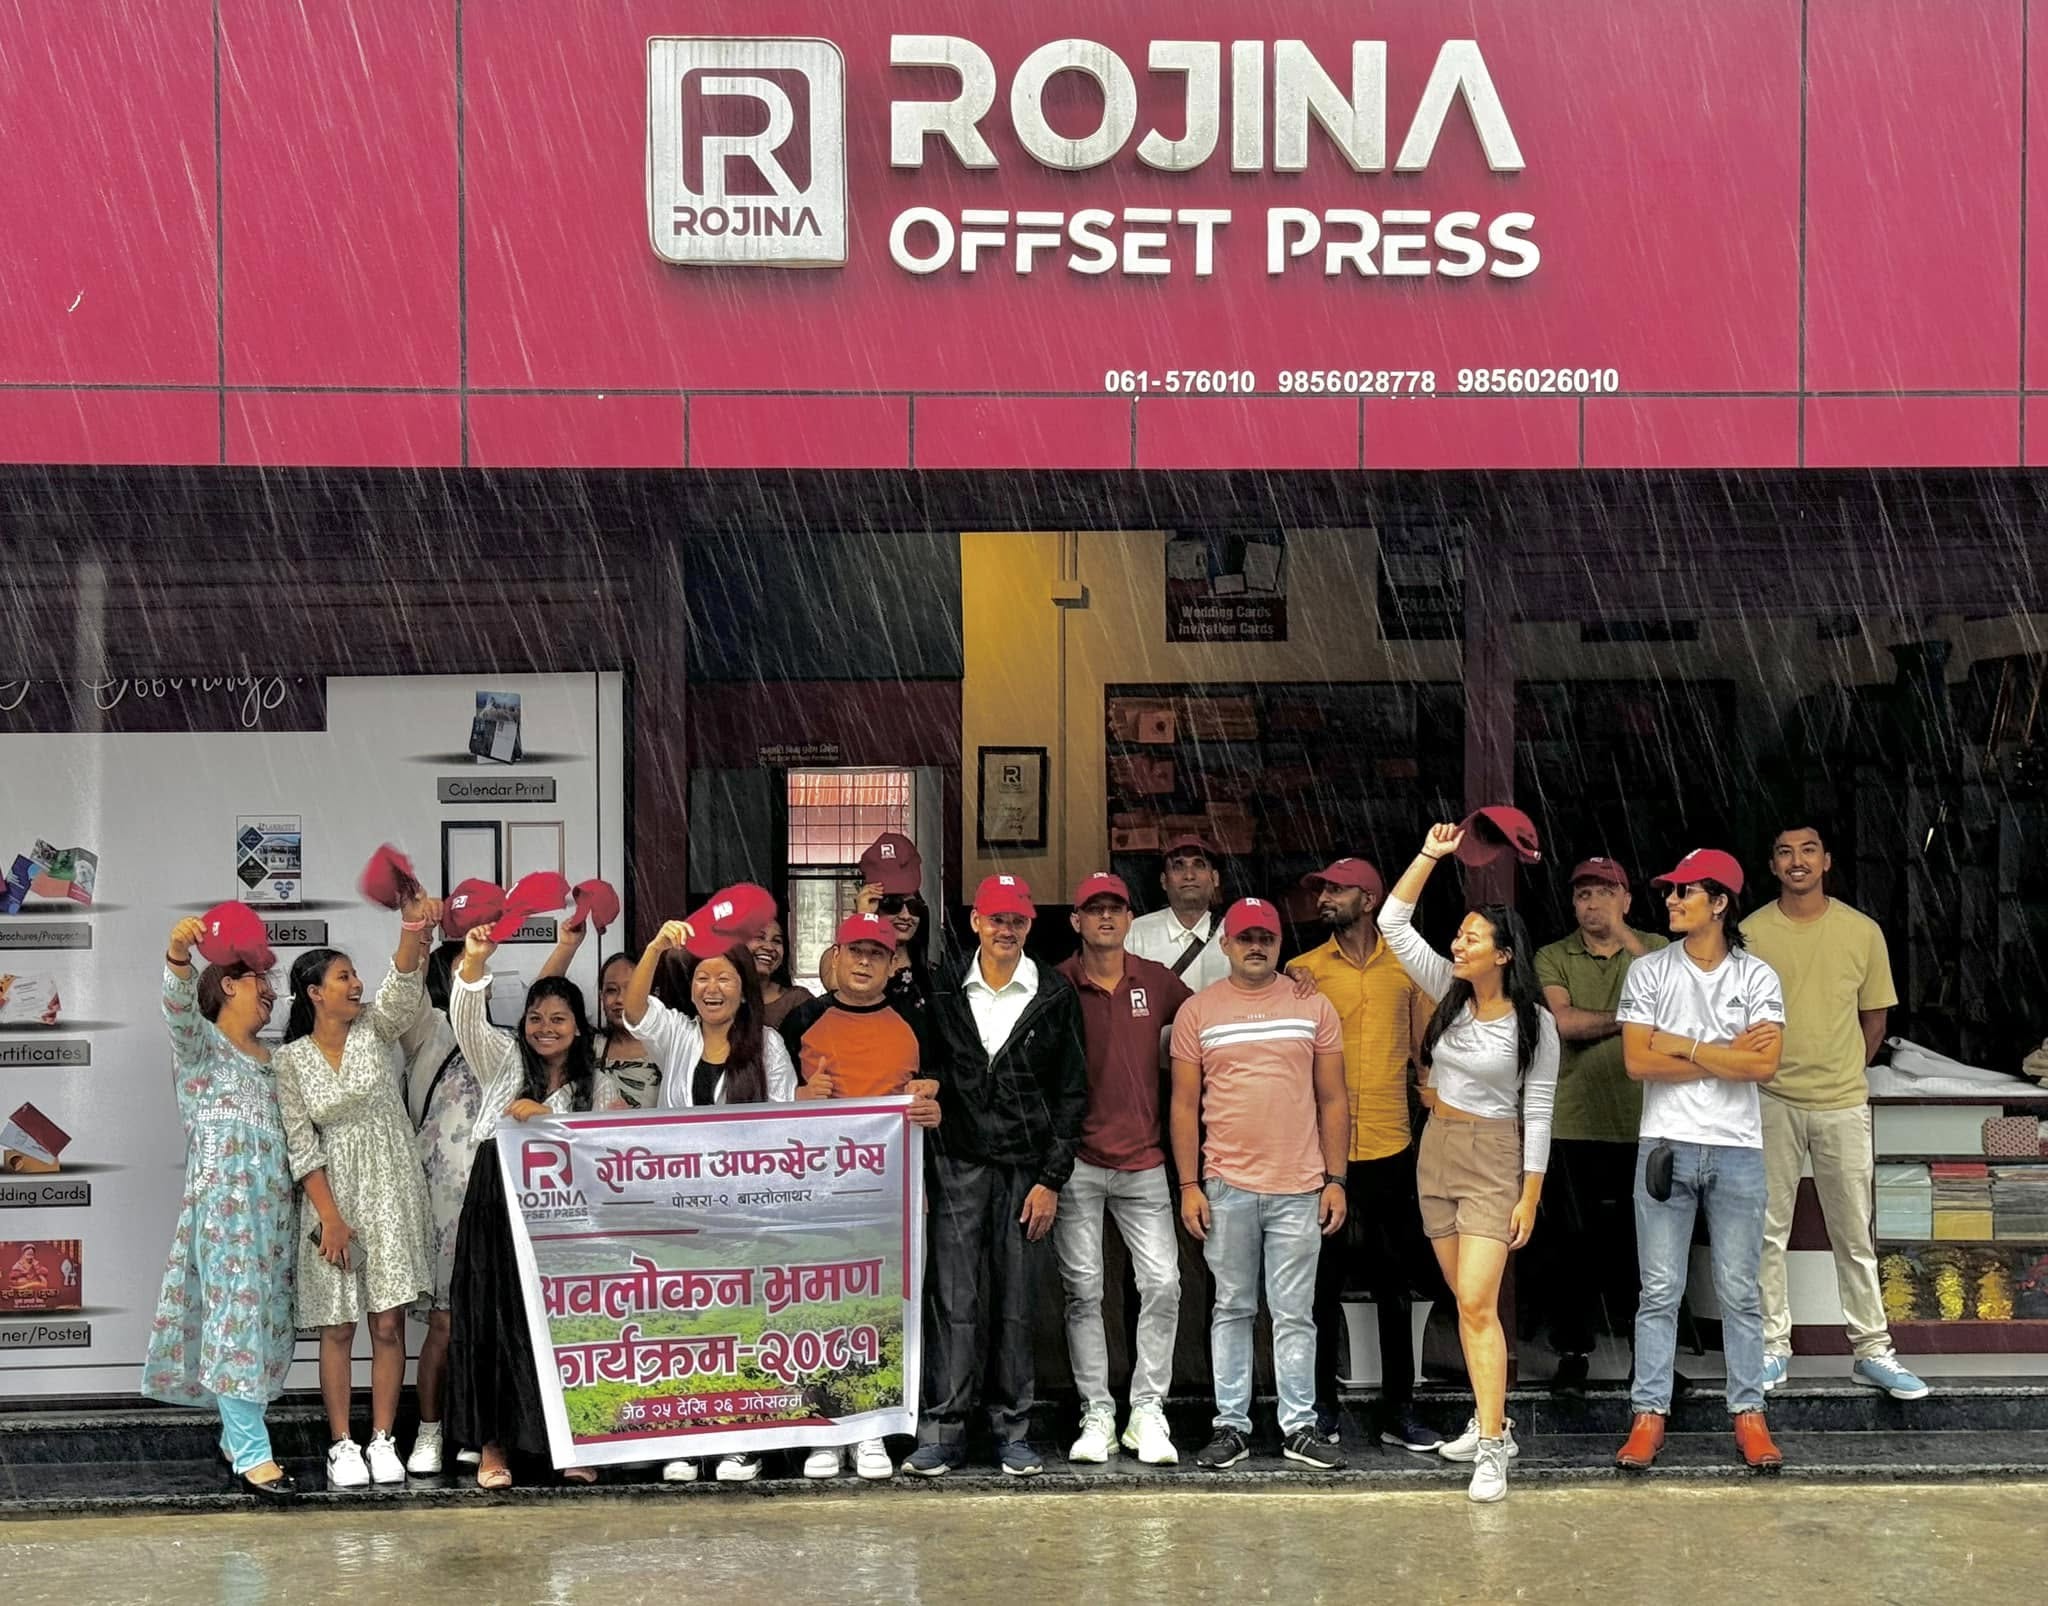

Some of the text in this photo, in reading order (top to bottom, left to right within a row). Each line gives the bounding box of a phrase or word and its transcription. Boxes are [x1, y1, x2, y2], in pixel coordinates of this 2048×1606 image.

[889, 34, 1526, 173] ROJINA
[672, 205, 824, 237] ROJINA
[889, 206, 1542, 280] OFFSET PRESS
[1104, 367, 1620, 394] 061-576010 9856028778 9856026010
[1181, 605, 1272, 620] Wedding Cards
[1240, 621, 1275, 636] Cards
[448, 782, 544, 797] Calendar Print
[265, 922, 308, 941] klets
[511, 925, 553, 938] ames
[0, 1044, 82, 1061] rtificates
[595, 1145, 703, 1193] रोजिना
[833, 1135, 888, 1179] प्रेस
[41, 1185, 87, 1200] Cards
[521, 1206, 589, 1221] FSET PRESS
[763, 1257, 886, 1315] भ्रमण
[676, 1396, 708, 1416] देखि
